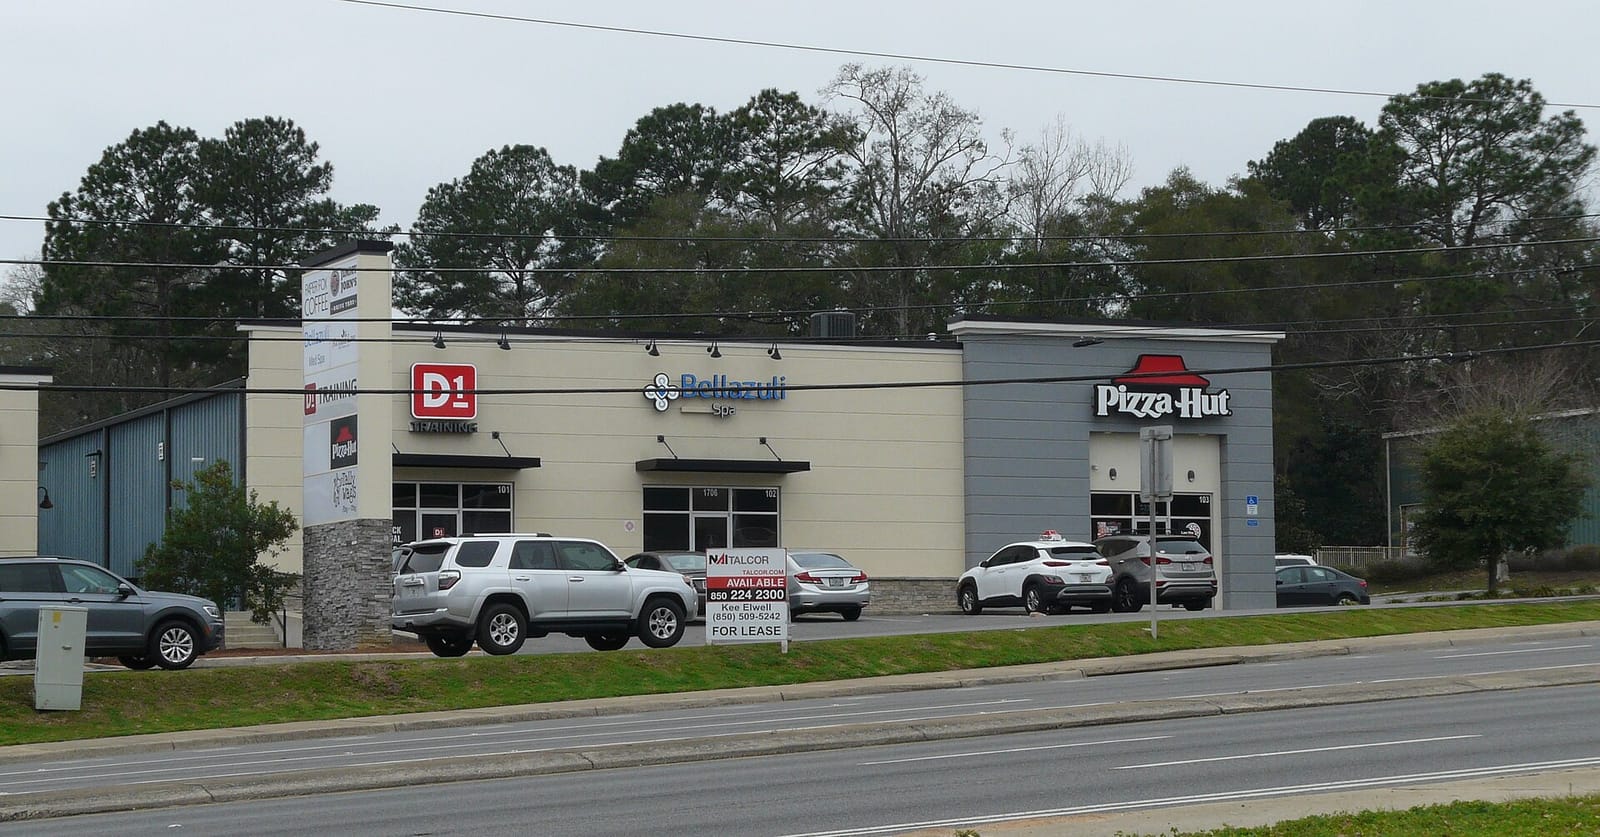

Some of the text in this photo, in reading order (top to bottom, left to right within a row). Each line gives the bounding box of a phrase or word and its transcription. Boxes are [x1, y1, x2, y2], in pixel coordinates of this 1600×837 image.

[304, 292, 329, 317] COFFEE
[319, 378, 357, 405] TRAINING
[423, 372, 469, 408] D1
[680, 373, 787, 400] Bellazuli
[1096, 384, 1230, 419] Pizza Hut
[711, 401, 737, 419] Spa
[408, 421, 479, 433] TRAINING
[497, 485, 511, 494] 101
[765, 489, 777, 498] 102
[1199, 496, 1210, 504] 103
[728, 555, 769, 565] TALCOR
[726, 578, 785, 588] AVAILABLE
[710, 589, 784, 600] 850 224 2300
[721, 603, 772, 612] Kee Elwell
[712, 612, 781, 622] (850) 509-5242
[712, 626, 782, 636] FOR LEASE
